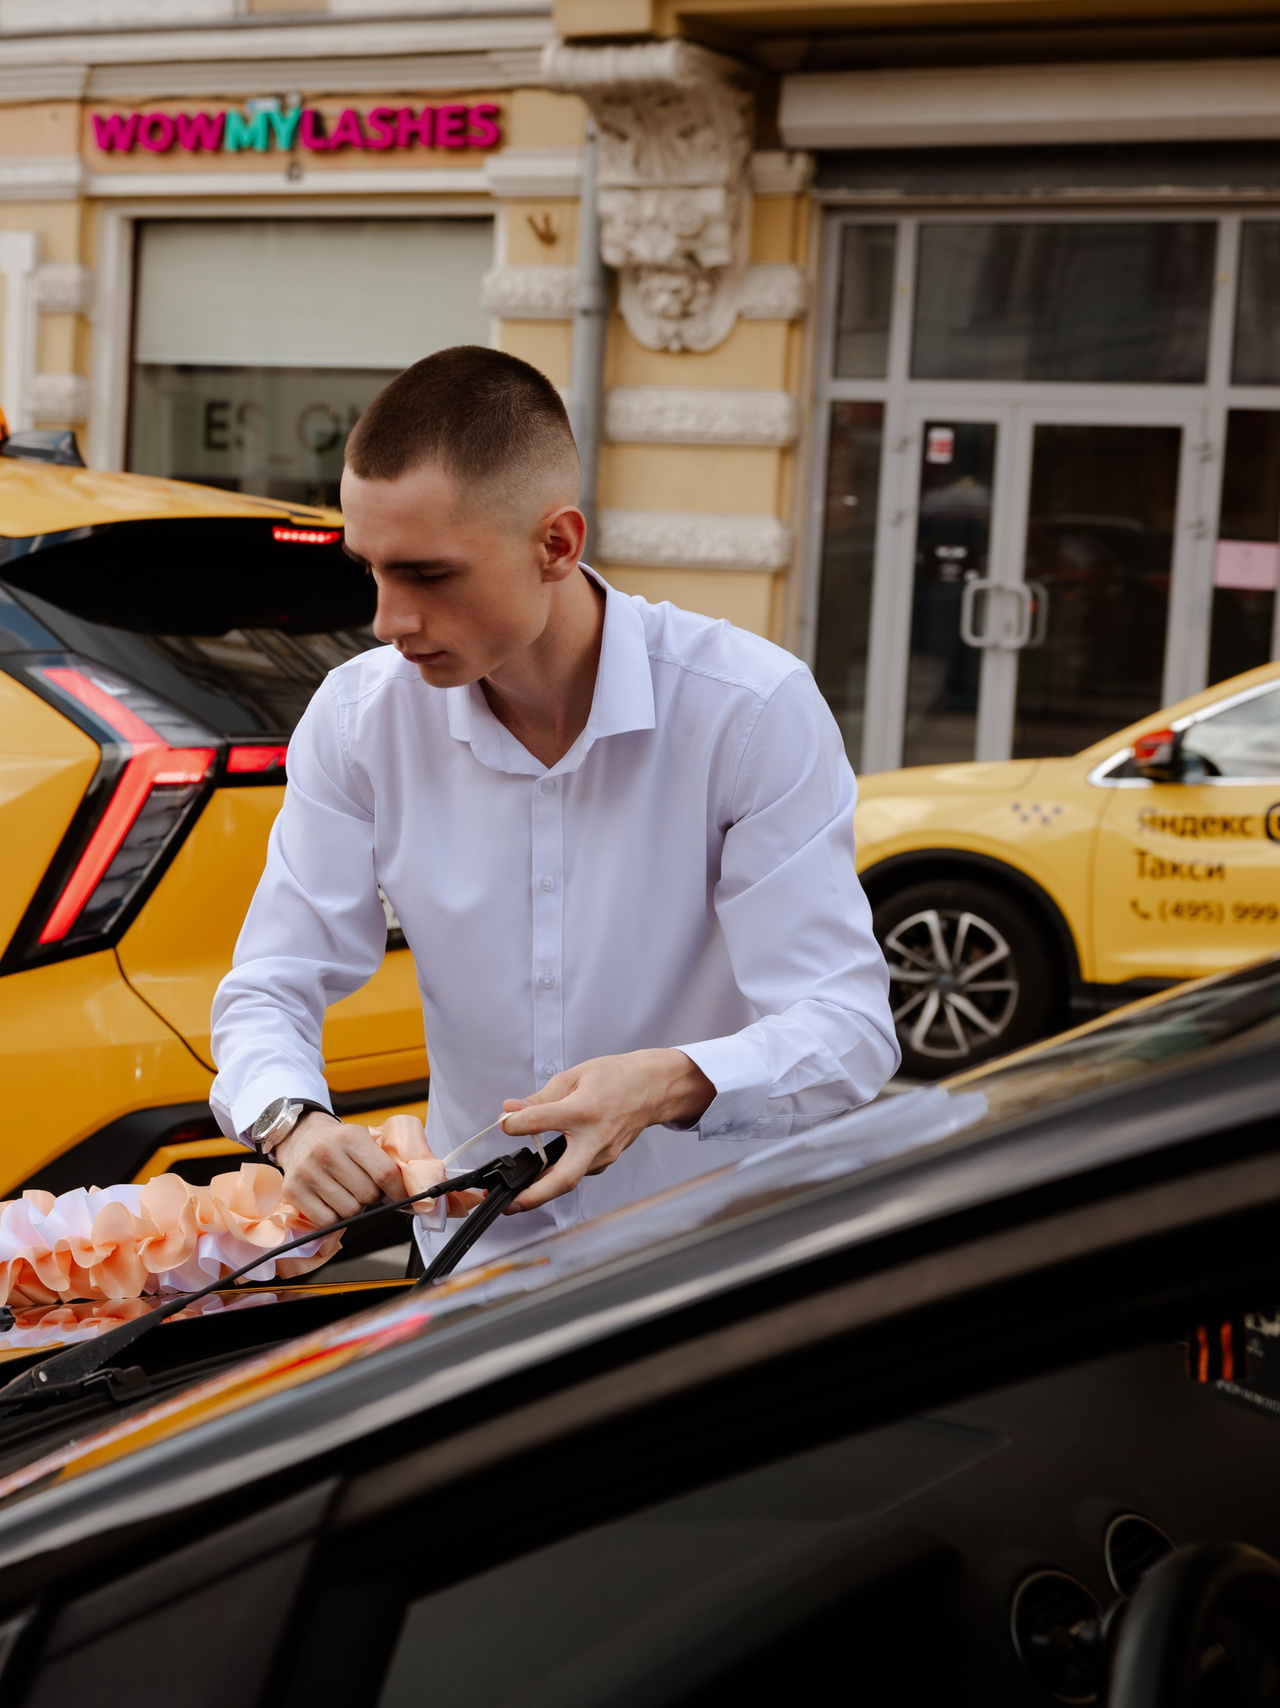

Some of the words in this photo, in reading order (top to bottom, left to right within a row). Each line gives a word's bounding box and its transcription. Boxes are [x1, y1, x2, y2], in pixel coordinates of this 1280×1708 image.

[1138, 806, 1255, 838] Яндекс
[1134, 849, 1225, 881] Такси
[1158, 899, 1225, 925] (495)
[1232, 901, 1280, 925] 999
